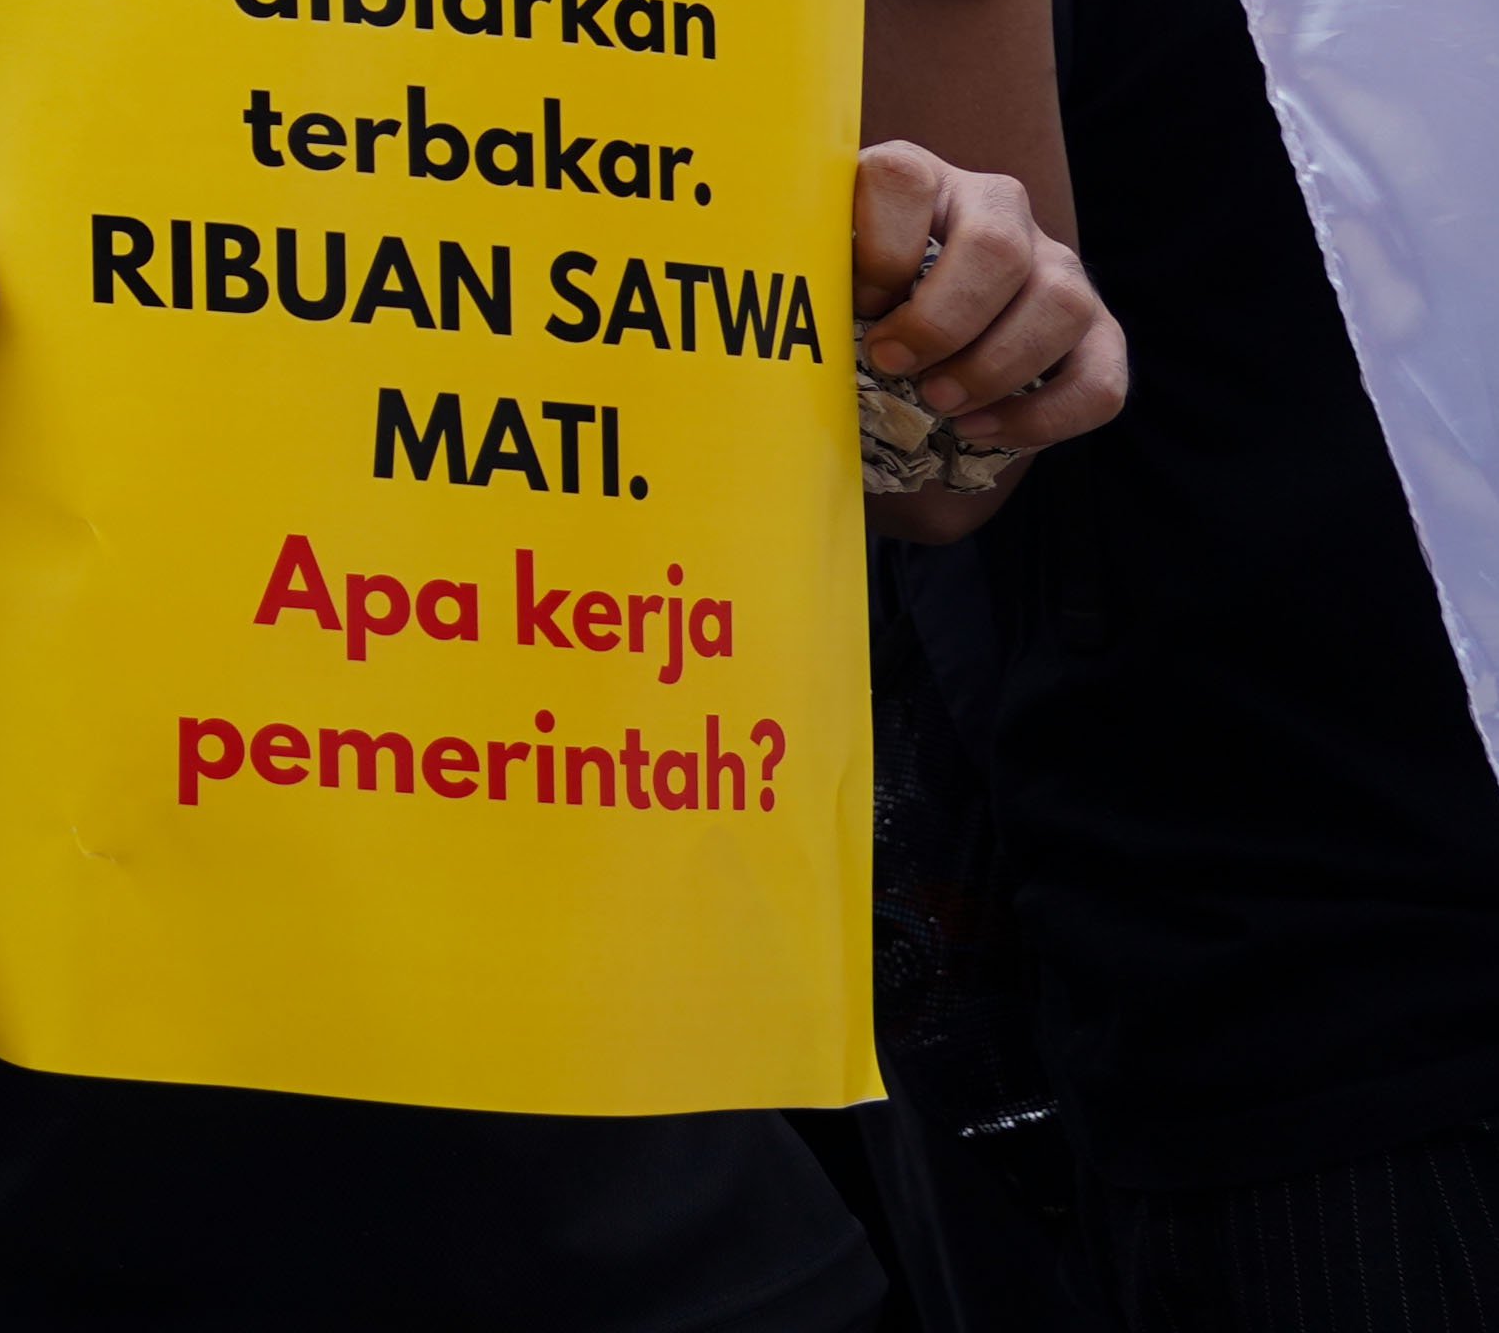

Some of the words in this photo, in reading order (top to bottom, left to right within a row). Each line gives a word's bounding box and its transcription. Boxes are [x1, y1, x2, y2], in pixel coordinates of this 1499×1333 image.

[243, 85, 713, 207] terbakar.
[91, 214, 512, 338] RIBUAN
[545, 249, 825, 366] SATWA
[371, 386, 649, 501] MATI.
[253, 532, 479, 662] Apa
[514, 547, 735, 685] kerja
[177, 709, 789, 813] pemerintah?
